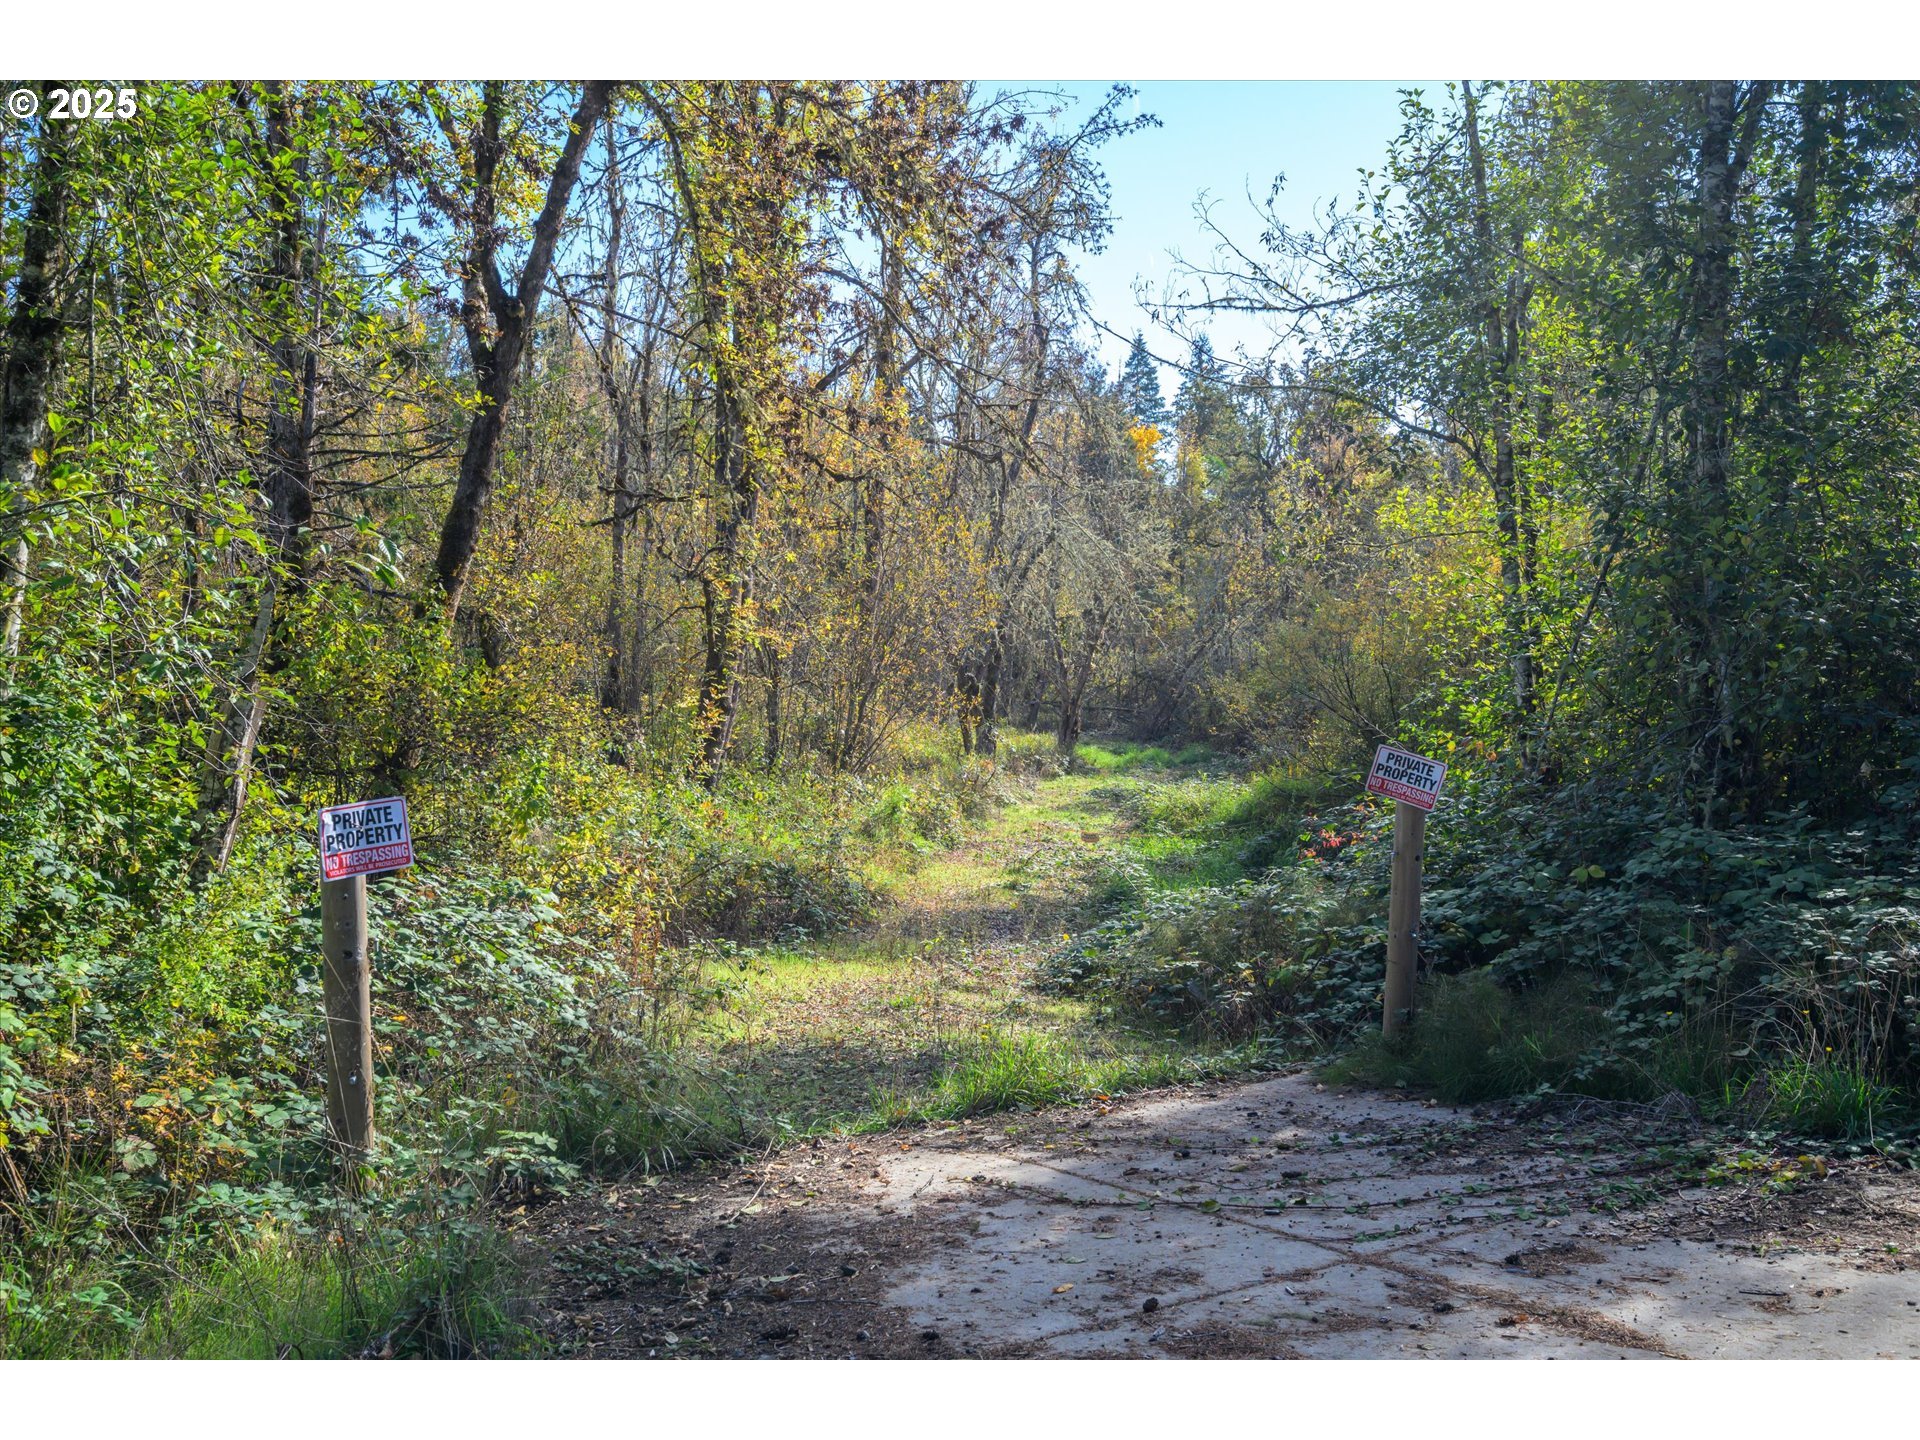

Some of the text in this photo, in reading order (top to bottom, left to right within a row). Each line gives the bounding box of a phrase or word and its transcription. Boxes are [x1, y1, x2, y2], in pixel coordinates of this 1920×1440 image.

[1375, 763, 1437, 791] PROPERTY
[1386, 752, 1435, 777] PRIVATE
[1370, 777, 1382, 787] NO
[1383, 780, 1434, 804] TRESPASSING
[332, 805, 393, 831] PRIVATE
[326, 823, 402, 852] PROPERTY
[326, 844, 408, 871] NO TRESPASSING
[330, 867, 355, 876] VIOLATORS
